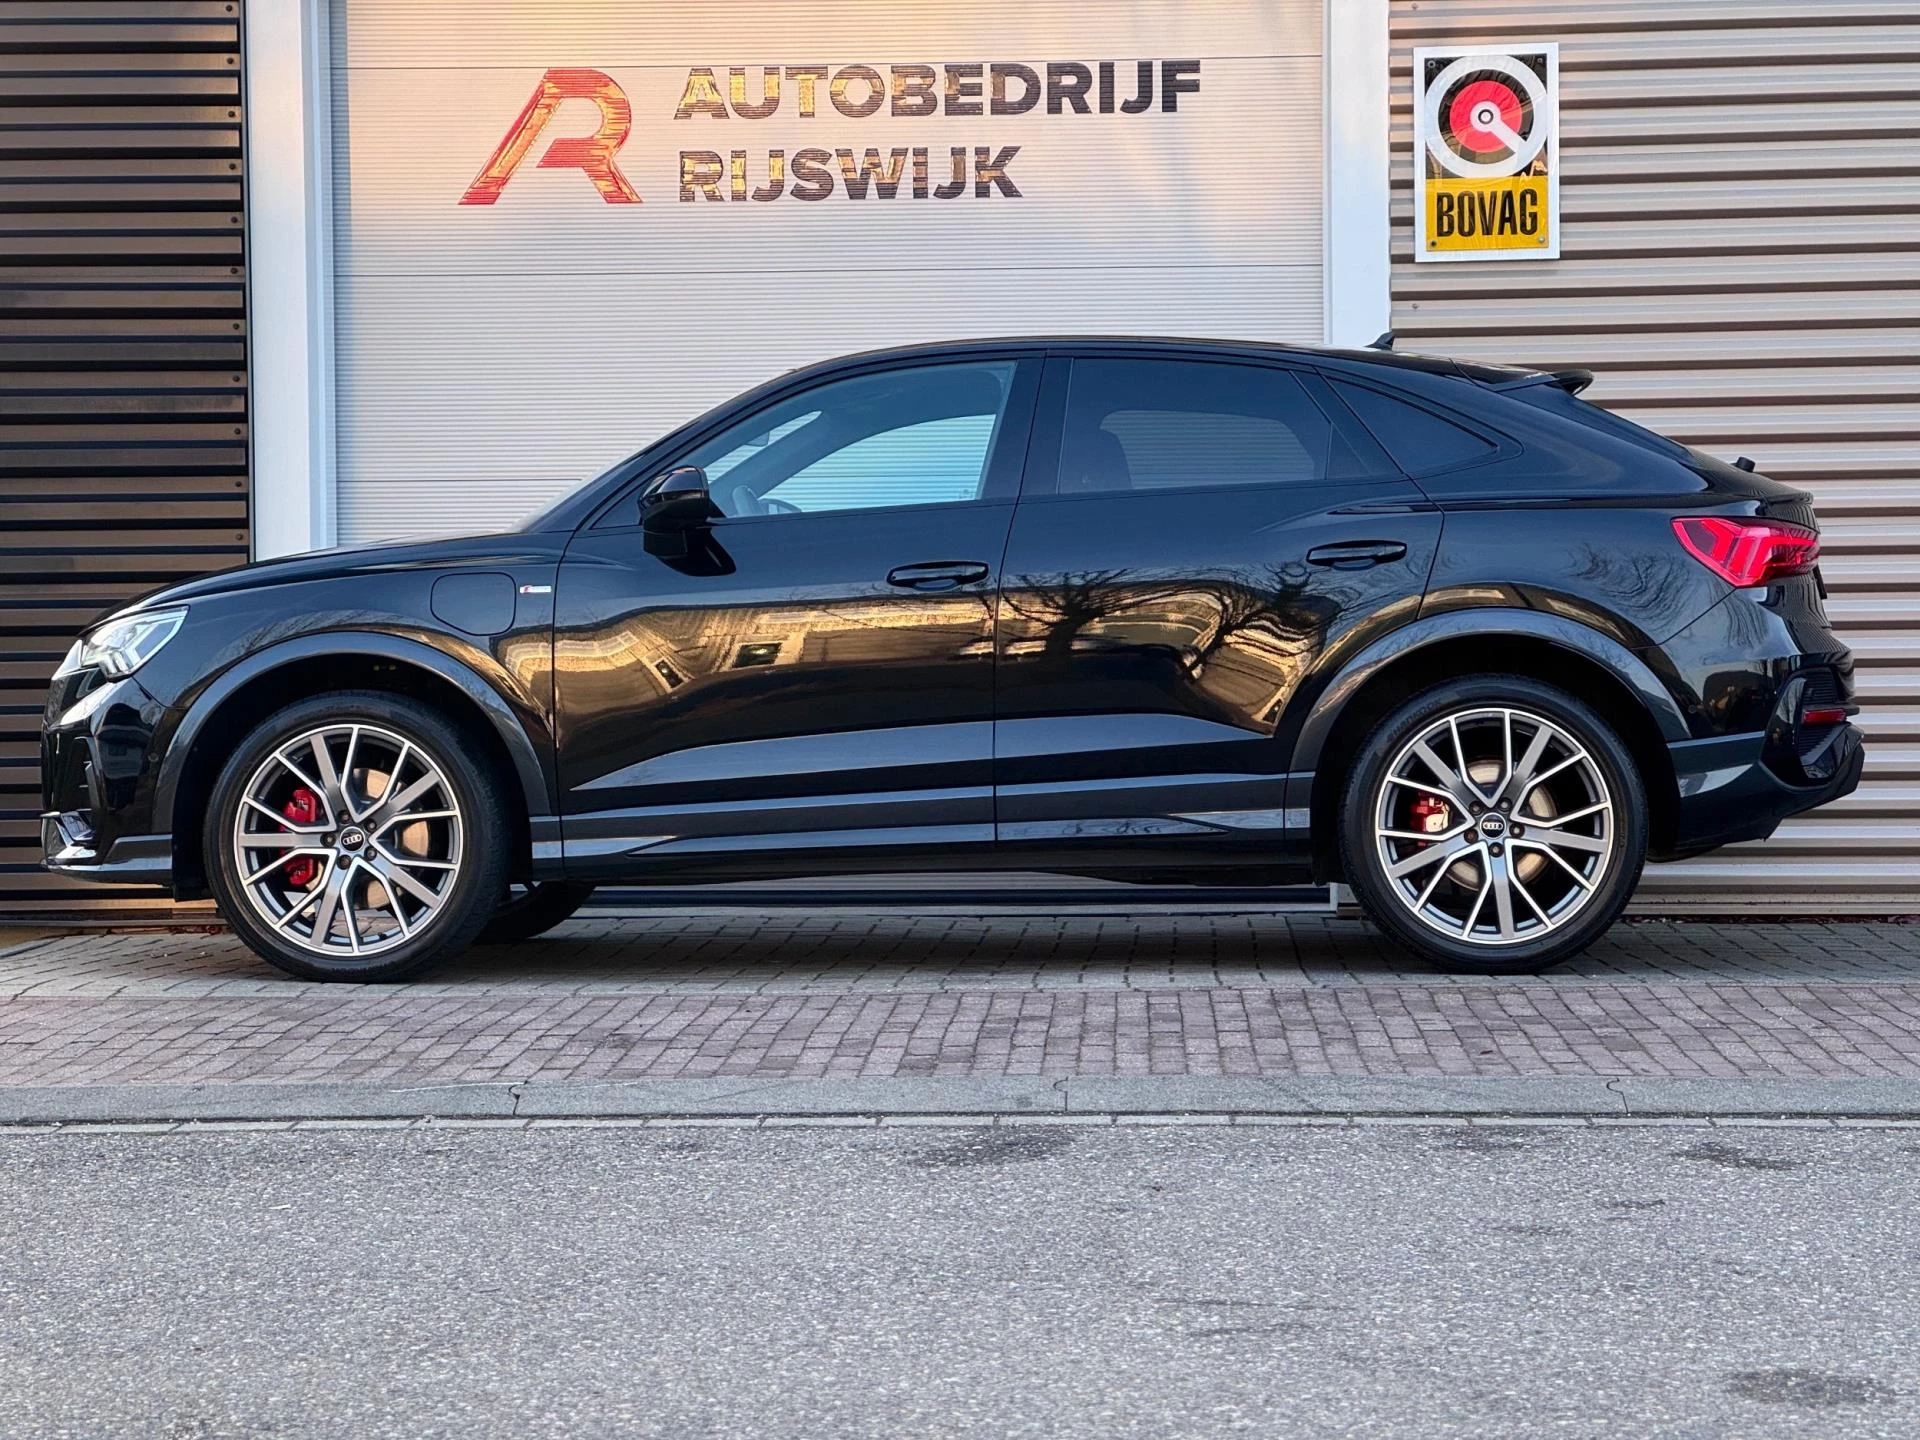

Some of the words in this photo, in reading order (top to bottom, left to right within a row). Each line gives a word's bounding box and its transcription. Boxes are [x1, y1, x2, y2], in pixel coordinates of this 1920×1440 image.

[673, 60, 1200, 120] AUTOBEDRIJF
[679, 145, 1023, 202] RIJSWIJK
[1436, 188, 1538, 237] BOVAG
